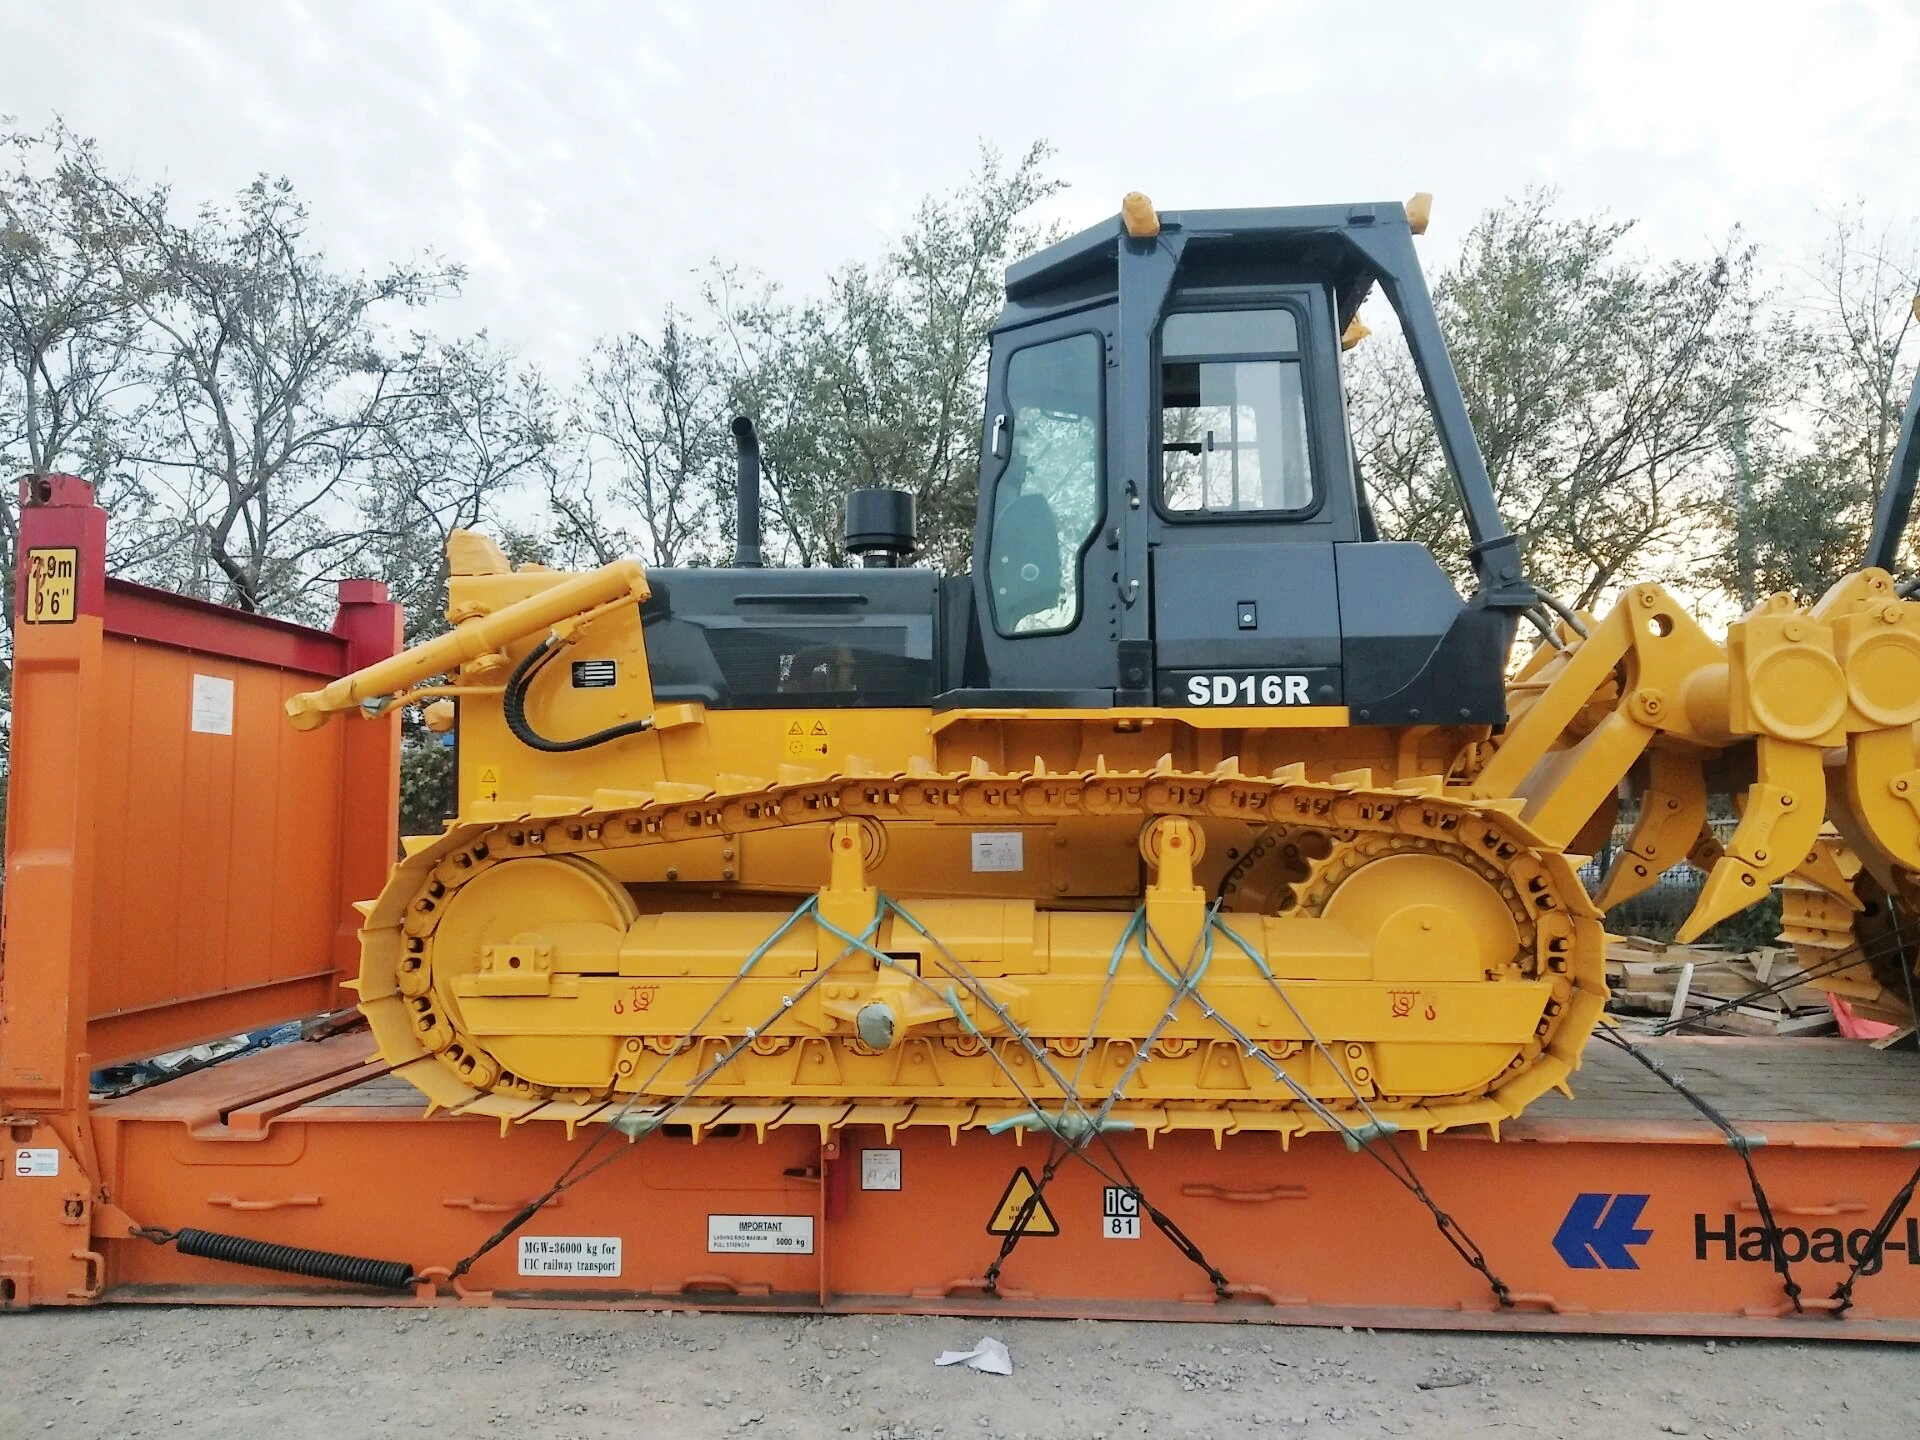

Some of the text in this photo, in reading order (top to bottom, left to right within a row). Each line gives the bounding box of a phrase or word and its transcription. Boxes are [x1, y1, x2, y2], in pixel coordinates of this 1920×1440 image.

[1187, 675, 1311, 706] SD16R
[739, 1221, 783, 1232] IMPORTANT
[1112, 1218, 1132, 1235] 81
[524, 1242, 616, 1257] MGW=36000 kg for
[776, 1237, 805, 1248] 5000 kg
[524, 1258, 615, 1273] UIC railway transport
